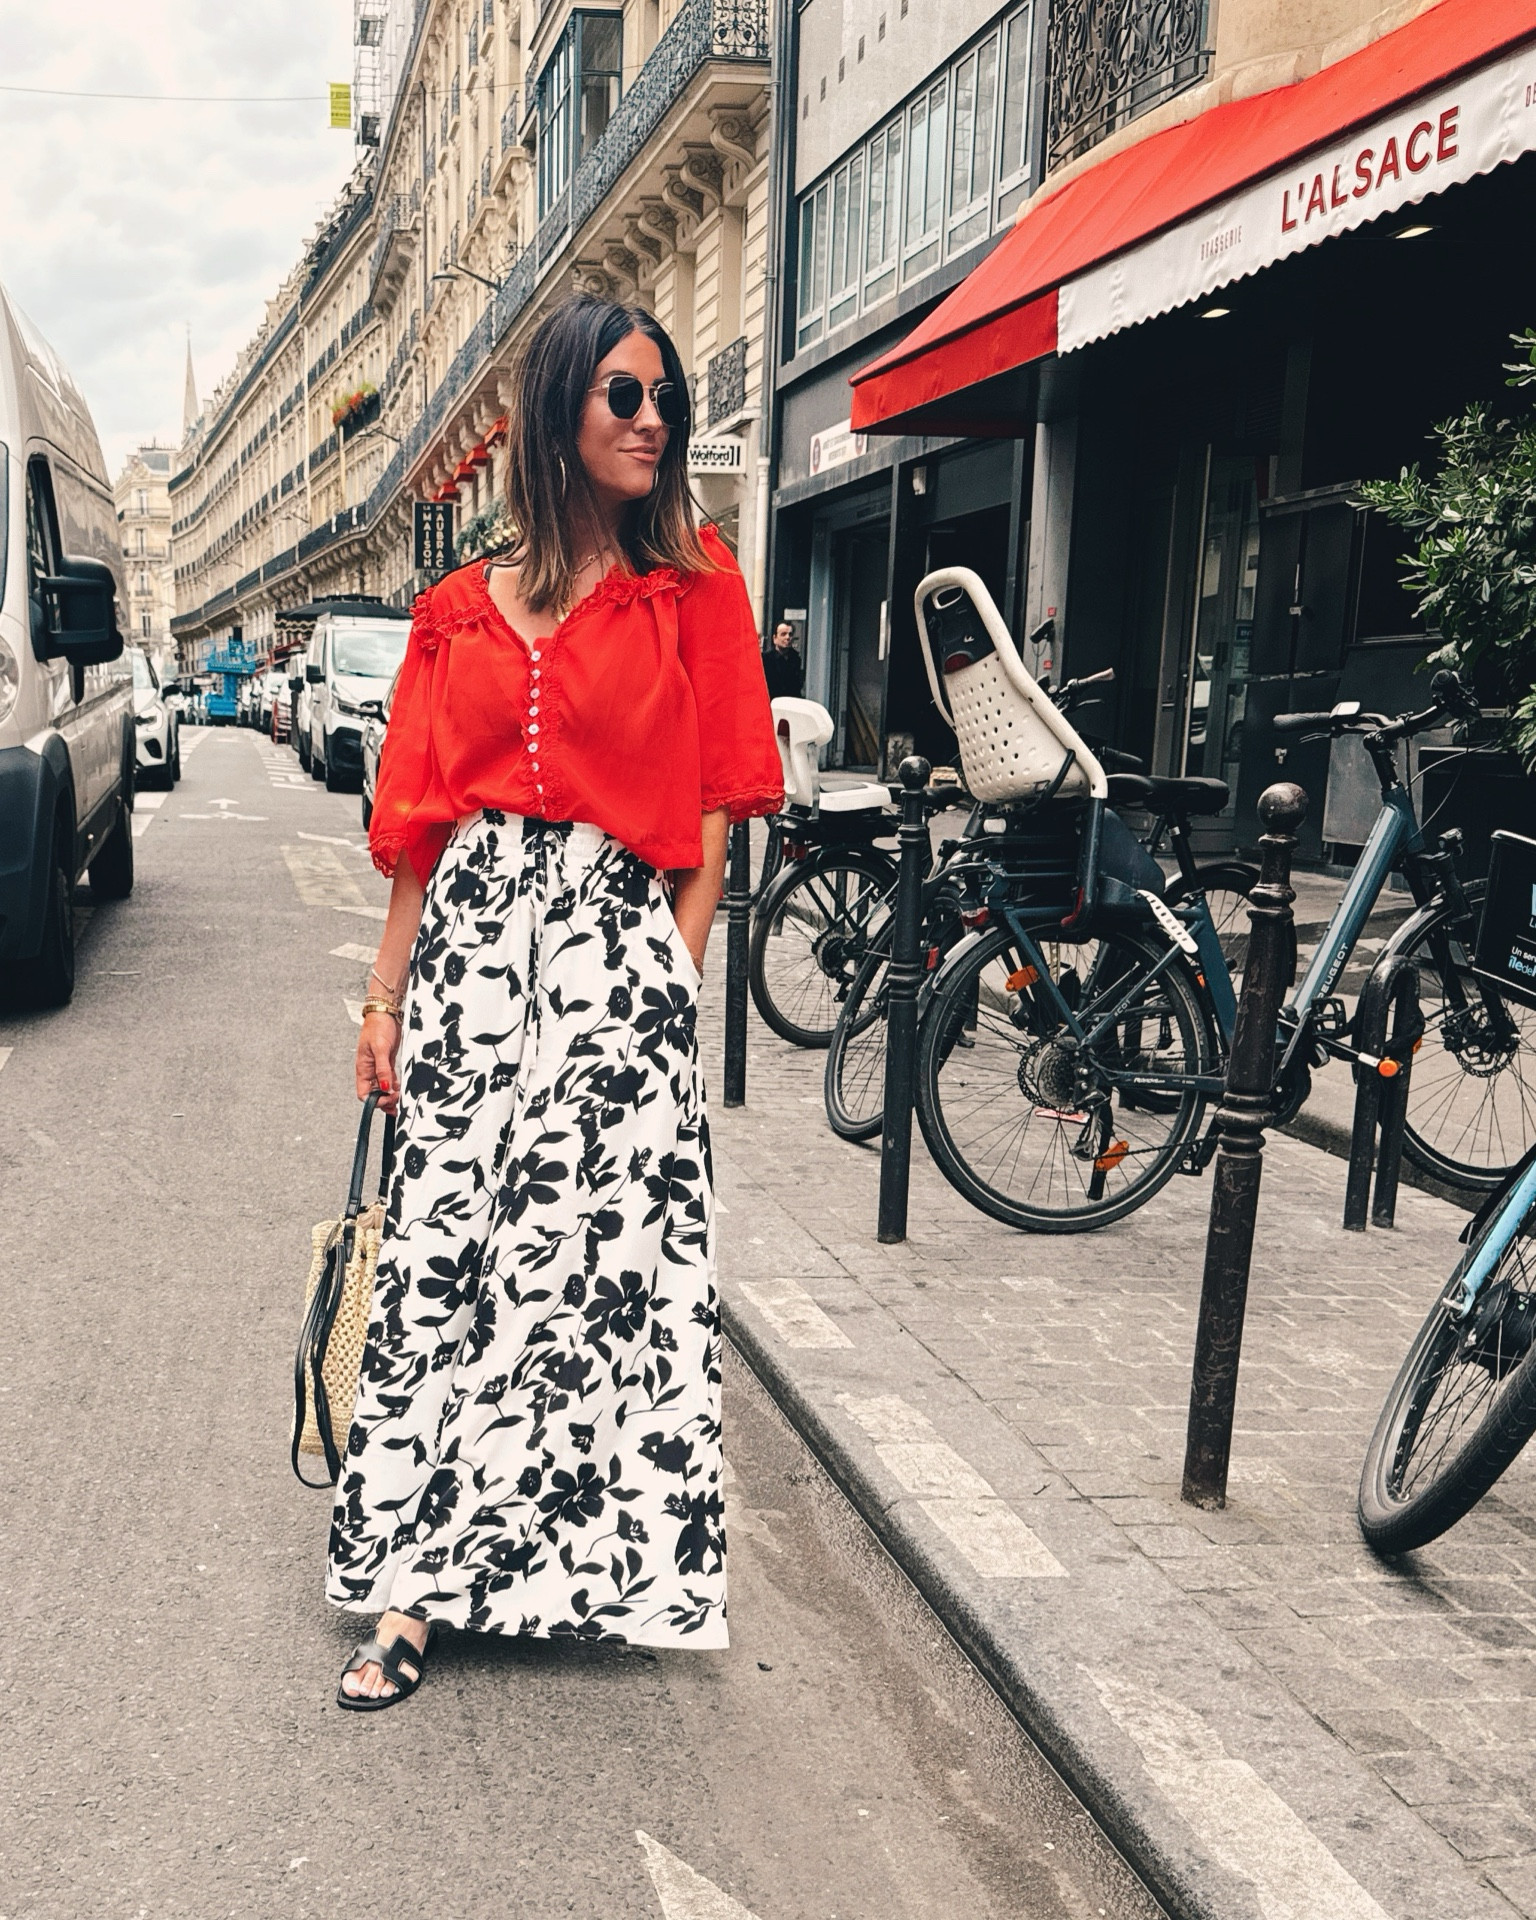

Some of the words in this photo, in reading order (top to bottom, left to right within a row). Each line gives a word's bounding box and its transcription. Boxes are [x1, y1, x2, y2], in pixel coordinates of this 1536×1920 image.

[1200, 224, 1242, 261] BRASSERIE
[1281, 105, 1460, 233] L'ALSACE
[689, 449, 730, 461] Wolford
[422, 511, 432, 568] MAISON
[435, 512, 445, 568] AUBRAC
[1317, 942, 1349, 998] PEUGEOT
[1511, 945, 1523, 957] Un
